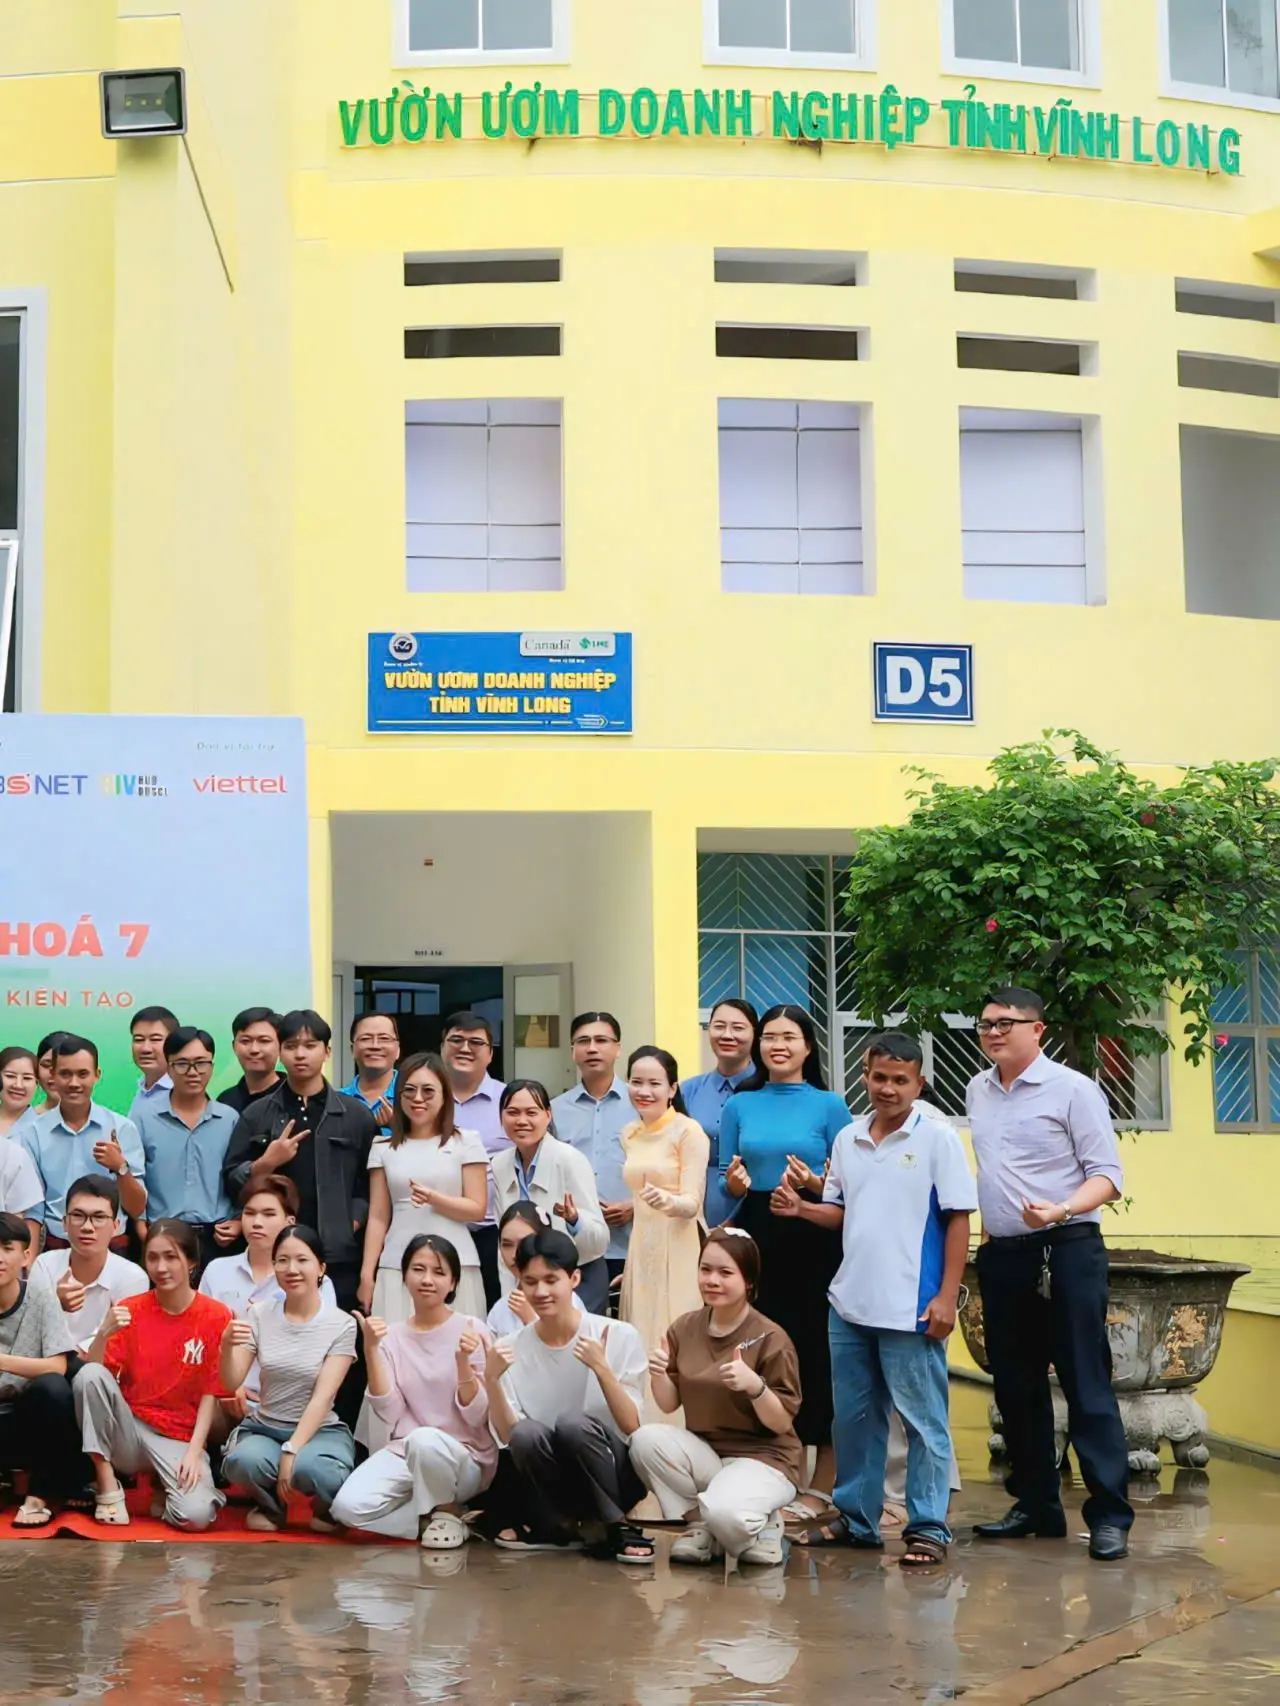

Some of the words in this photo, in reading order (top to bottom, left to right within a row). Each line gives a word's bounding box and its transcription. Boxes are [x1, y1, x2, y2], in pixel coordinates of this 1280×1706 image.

[339, 80, 462, 146] VƯỜN
[482, 81, 579, 138] ƯƠM
[599, 87, 752, 137] DOANH
[773, 84, 930, 151] NGHIỆP
[941, 84, 1026, 150] TỈNH
[1034, 98, 1119, 159] VĨNH
[1133, 116, 1240, 176] LONG
[384, 669, 432, 689] VƯỜN
[438, 671, 478, 689] ƯƠM
[484, 672, 545, 689] DOANH
[551, 669, 616, 692] NGHIỆP
[886, 655, 963, 707] D5
[429, 691, 470, 713] TỈNH
[476, 694, 518, 713] VĨNH
[524, 697, 572, 713] LONG
[192, 774, 288, 793] viettel
[119, 924, 150, 958] 7
